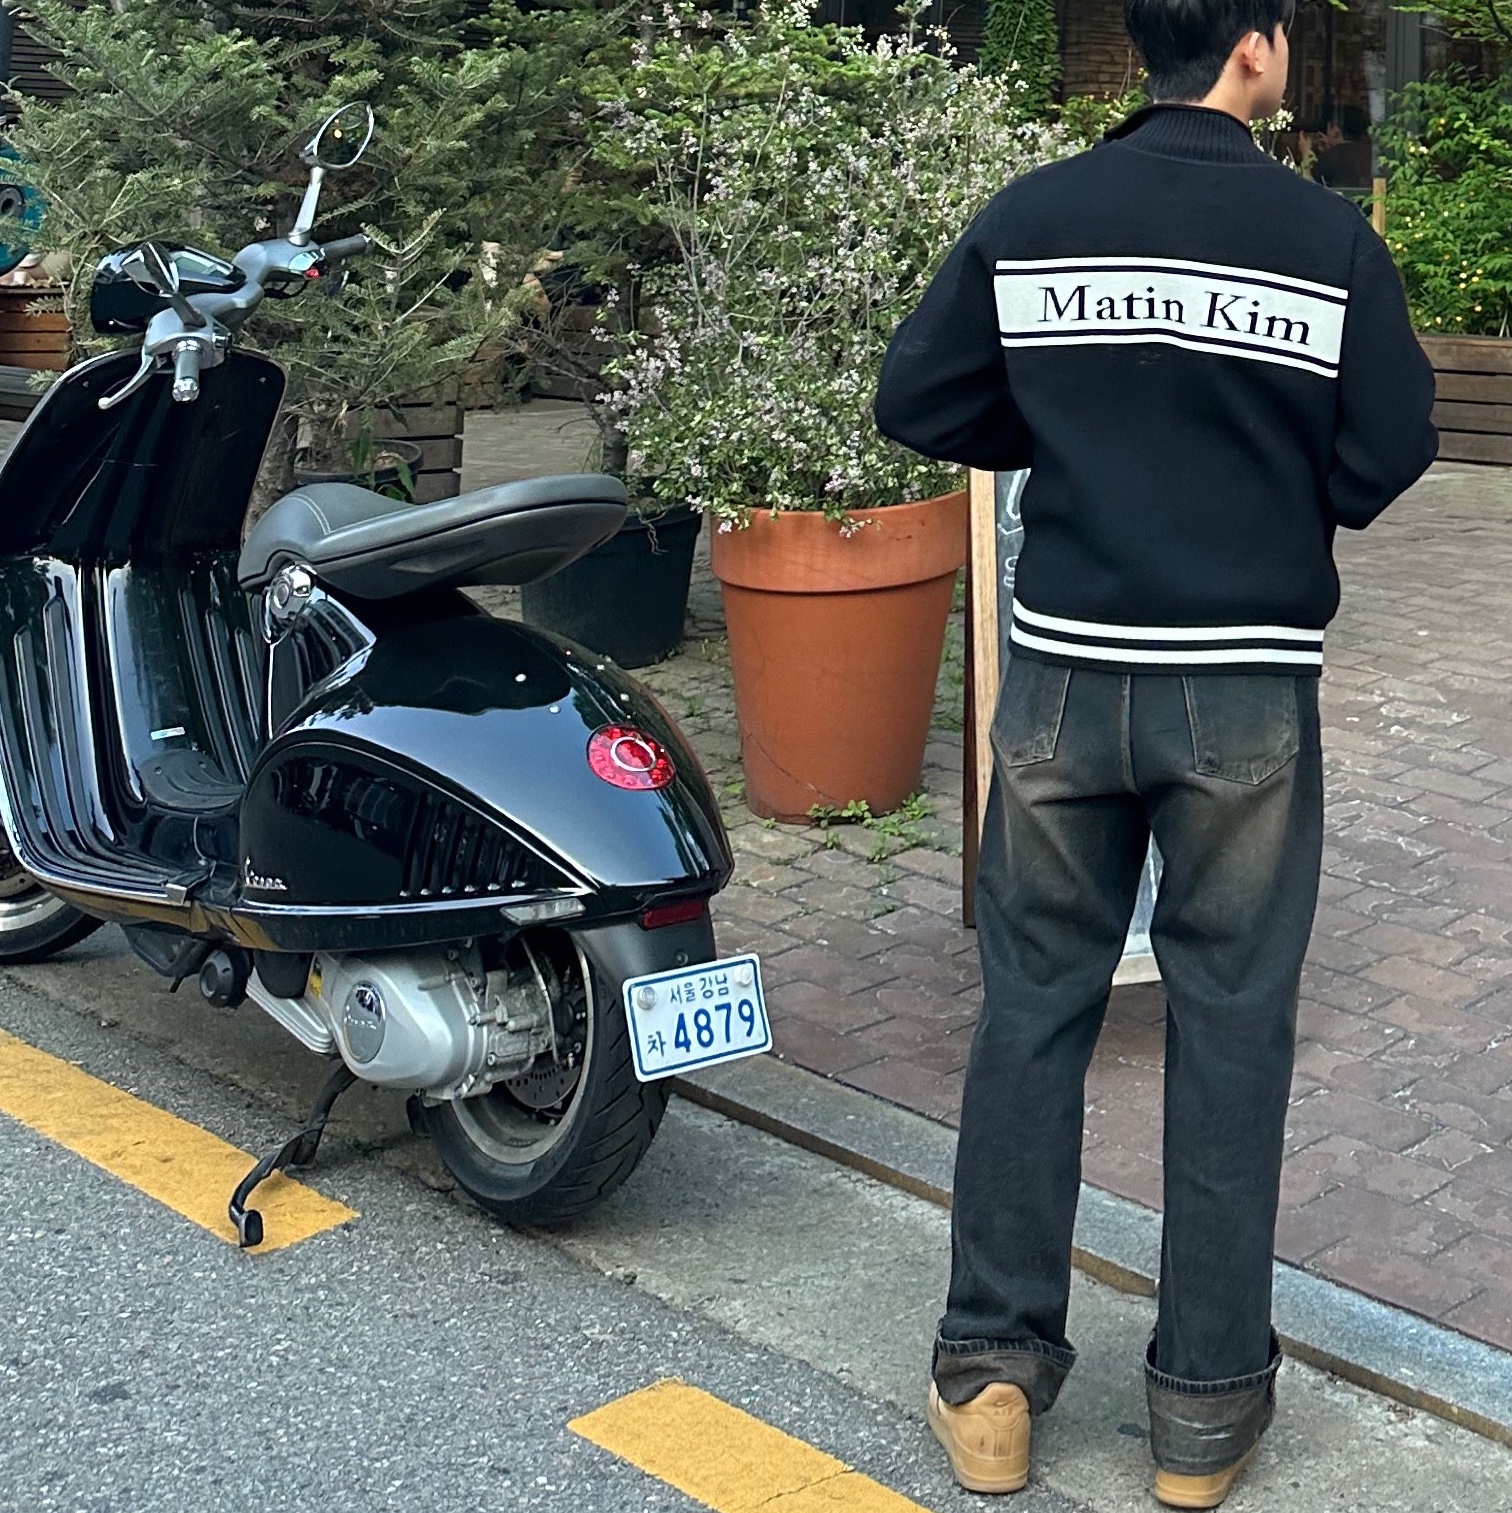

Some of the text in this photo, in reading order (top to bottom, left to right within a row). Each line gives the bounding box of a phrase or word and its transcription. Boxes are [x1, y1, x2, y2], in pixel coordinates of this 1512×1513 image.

[1037, 284, 1311, 346] Matin Kim
[647, 998, 755, 1058] 차 4879
